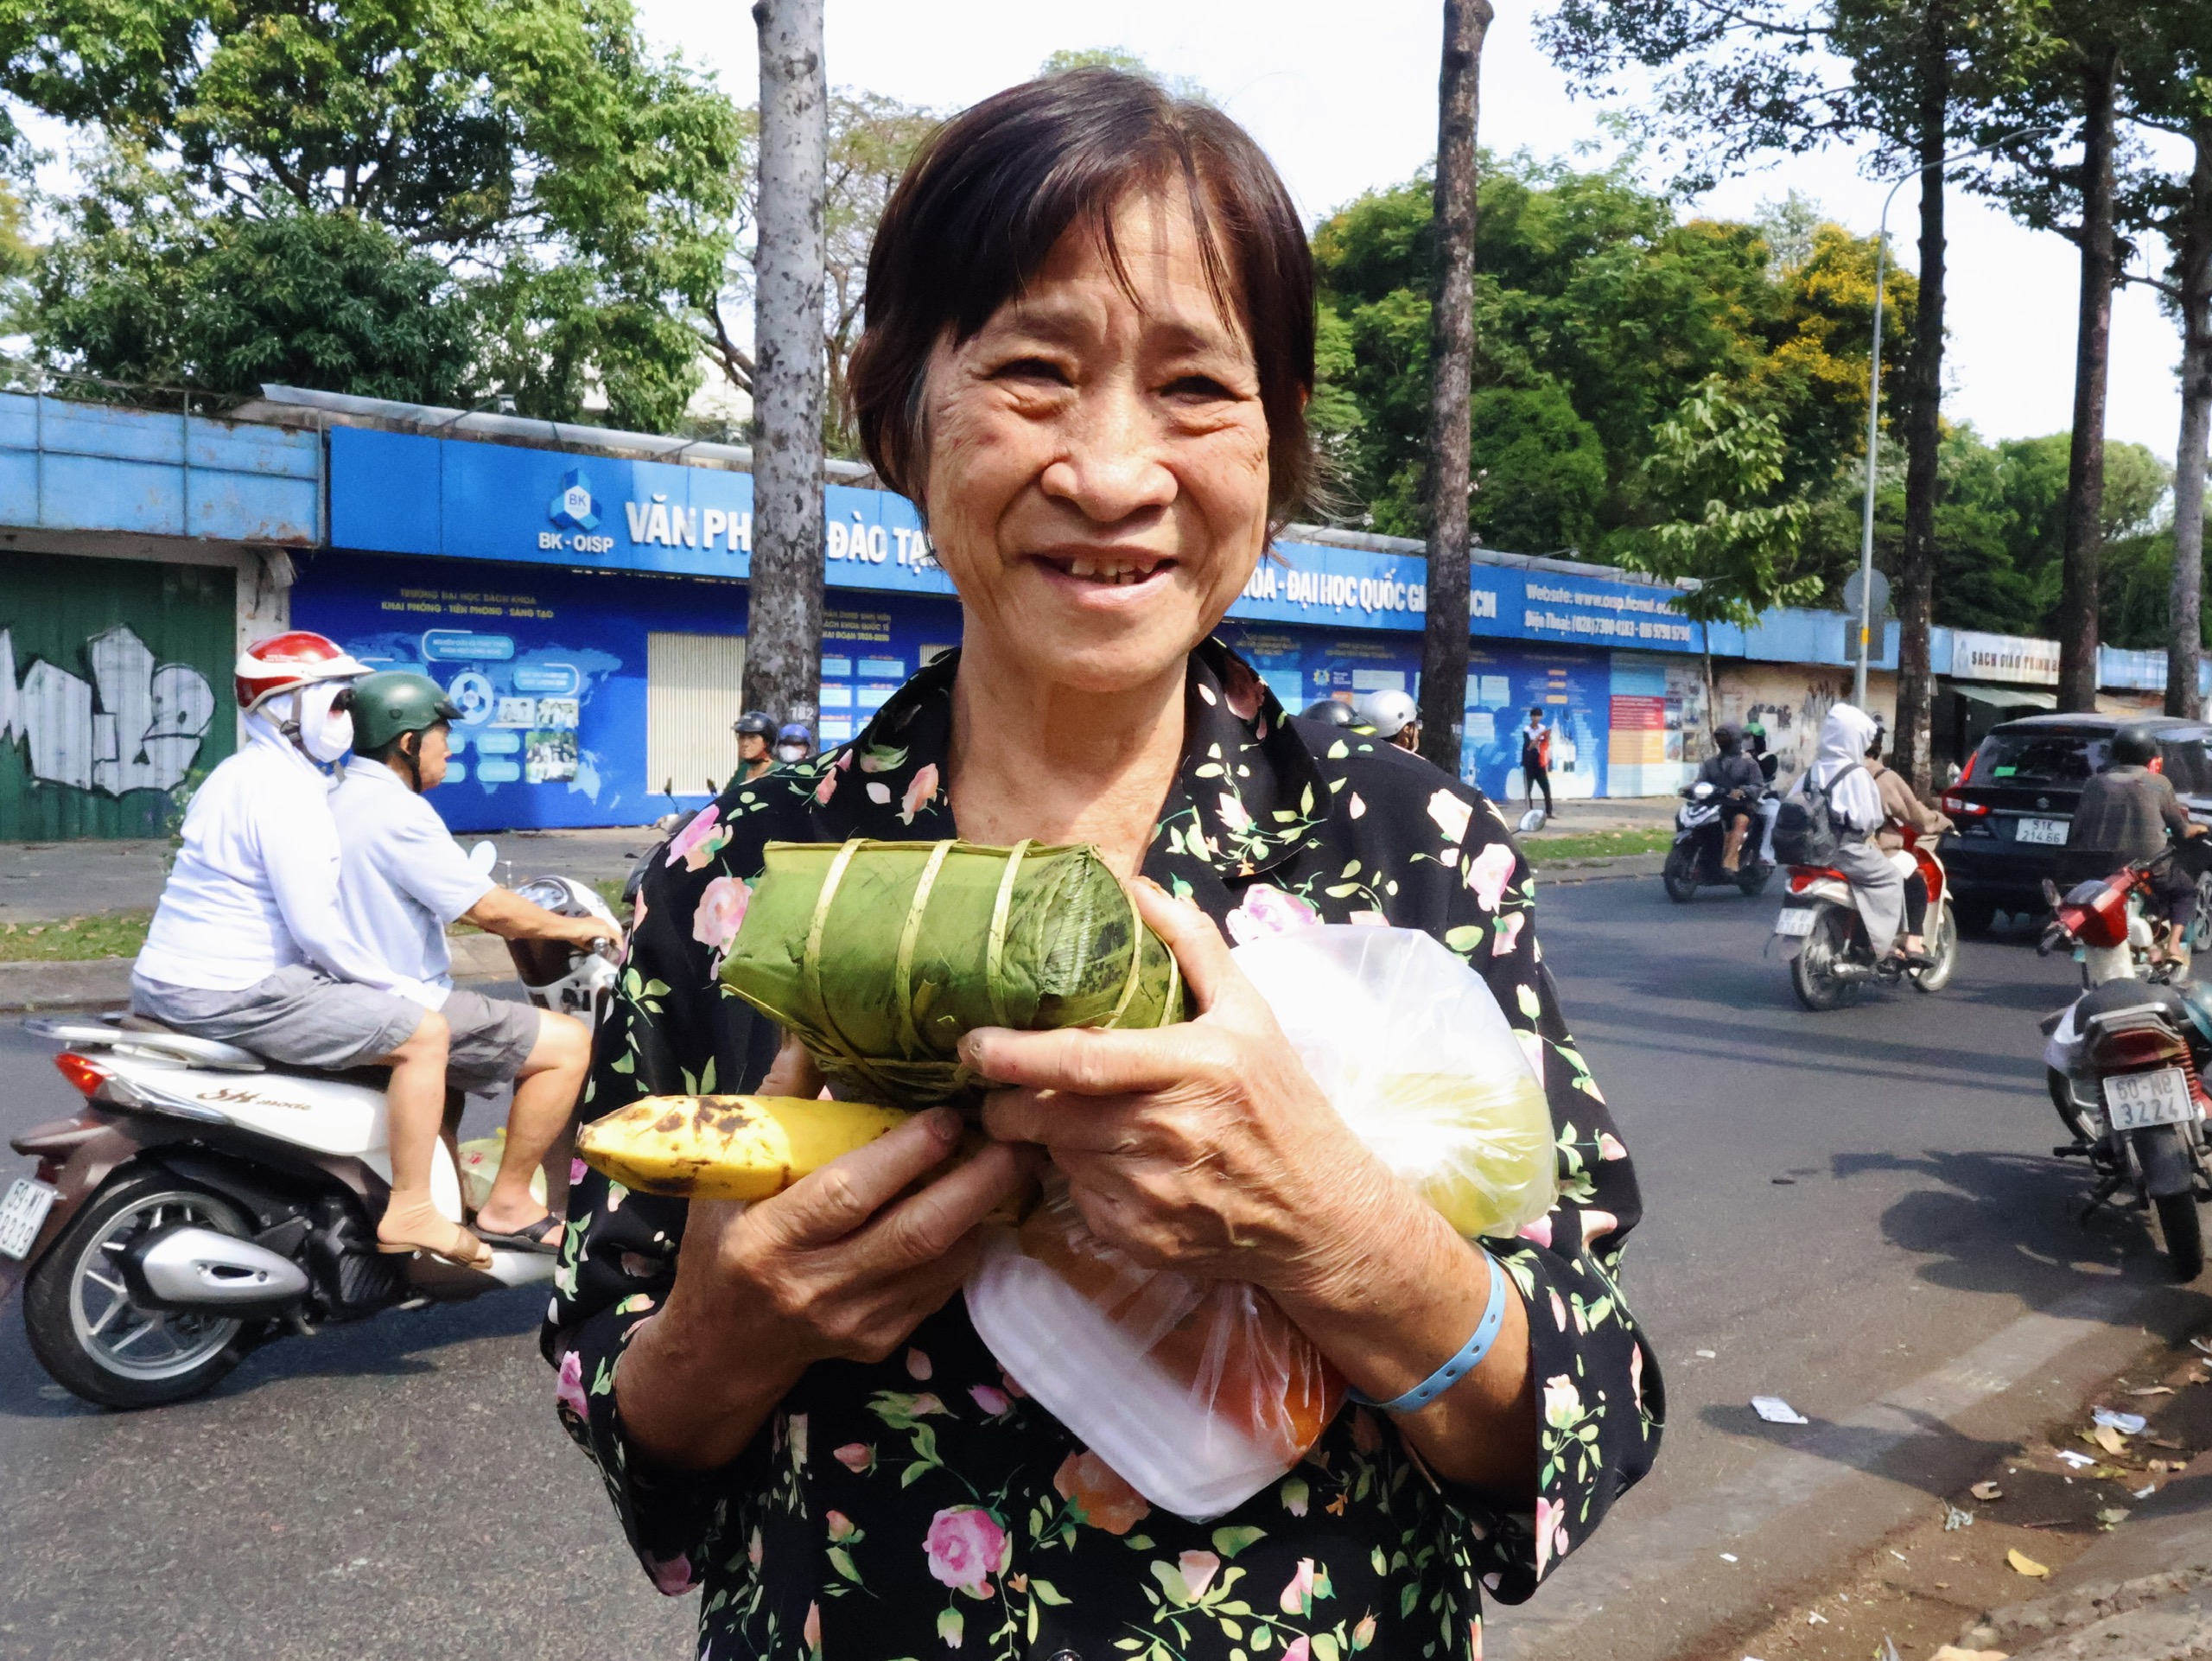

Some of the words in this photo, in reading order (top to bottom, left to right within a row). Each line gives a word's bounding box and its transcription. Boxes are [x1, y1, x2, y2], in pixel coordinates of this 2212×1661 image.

[569, 493, 587, 507] BK
[625, 493, 696, 549] VĂN
[827, 511, 888, 563] ĐÀO
[893, 526, 937, 574] TẠ
[1287, 570, 1319, 610] ĐẠI
[1320, 574, 1357, 614] HỌC
[1360, 567, 1406, 614] QUỐC
[1408, 583, 1427, 613] GI
[1525, 583, 1573, 604] Website:
